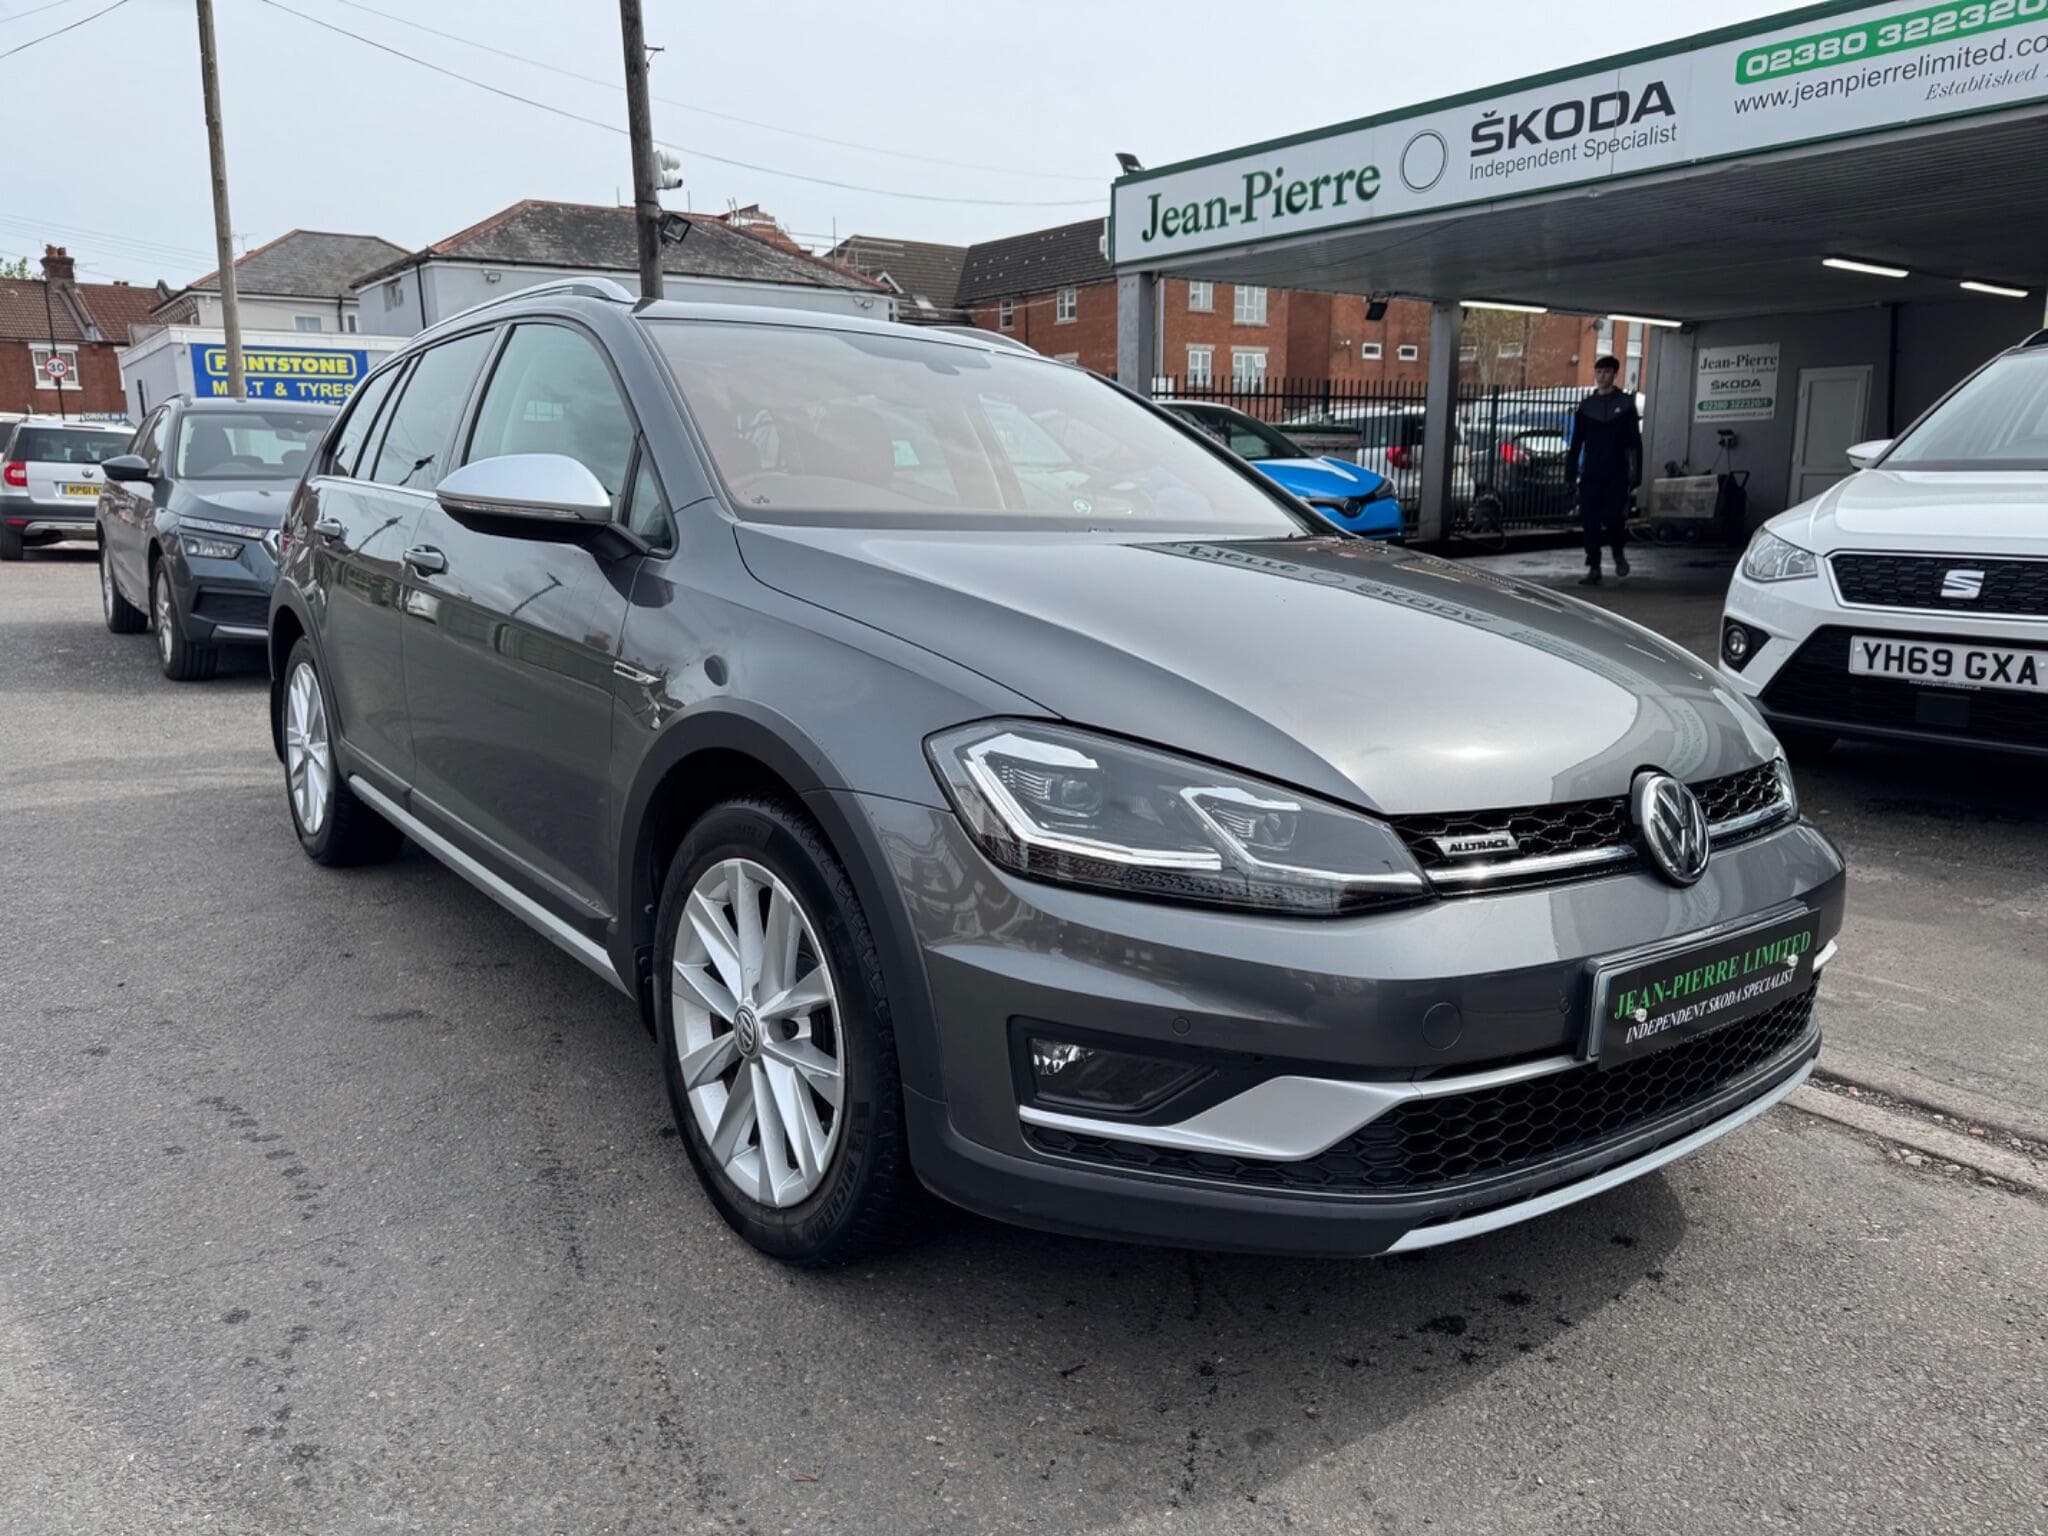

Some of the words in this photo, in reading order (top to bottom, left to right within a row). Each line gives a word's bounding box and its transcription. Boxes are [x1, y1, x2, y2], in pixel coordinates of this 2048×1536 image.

[1745, 31, 1868, 77] 02380
[1877, 0, 2048, 48] 322320
[1926, 63, 2040, 101] Established
[1470, 81, 1677, 158] ŠKODA
[1470, 143, 1578, 181] Independent
[1583, 123, 1678, 162] Specialist
[1142, 165, 1381, 243] Jean-Pierre
[48, 362, 65, 373] 30
[1701, 353, 1777, 370] Jean-Pierre
[274, 382, 288, 396] &
[297, 382, 354, 398] TYRES
[1863, 642, 1954, 678] YH69
[1964, 651, 2039, 686] GXA
[1451, 839, 1509, 852] ALLTRACK
[1614, 955, 1740, 1020] JEAN-PIERRE
[1743, 930, 1812, 975] LIMITED
[1625, 1000, 1706, 1044] INDEPENDENT
[1741, 967, 1797, 1001] SPECIALIST
